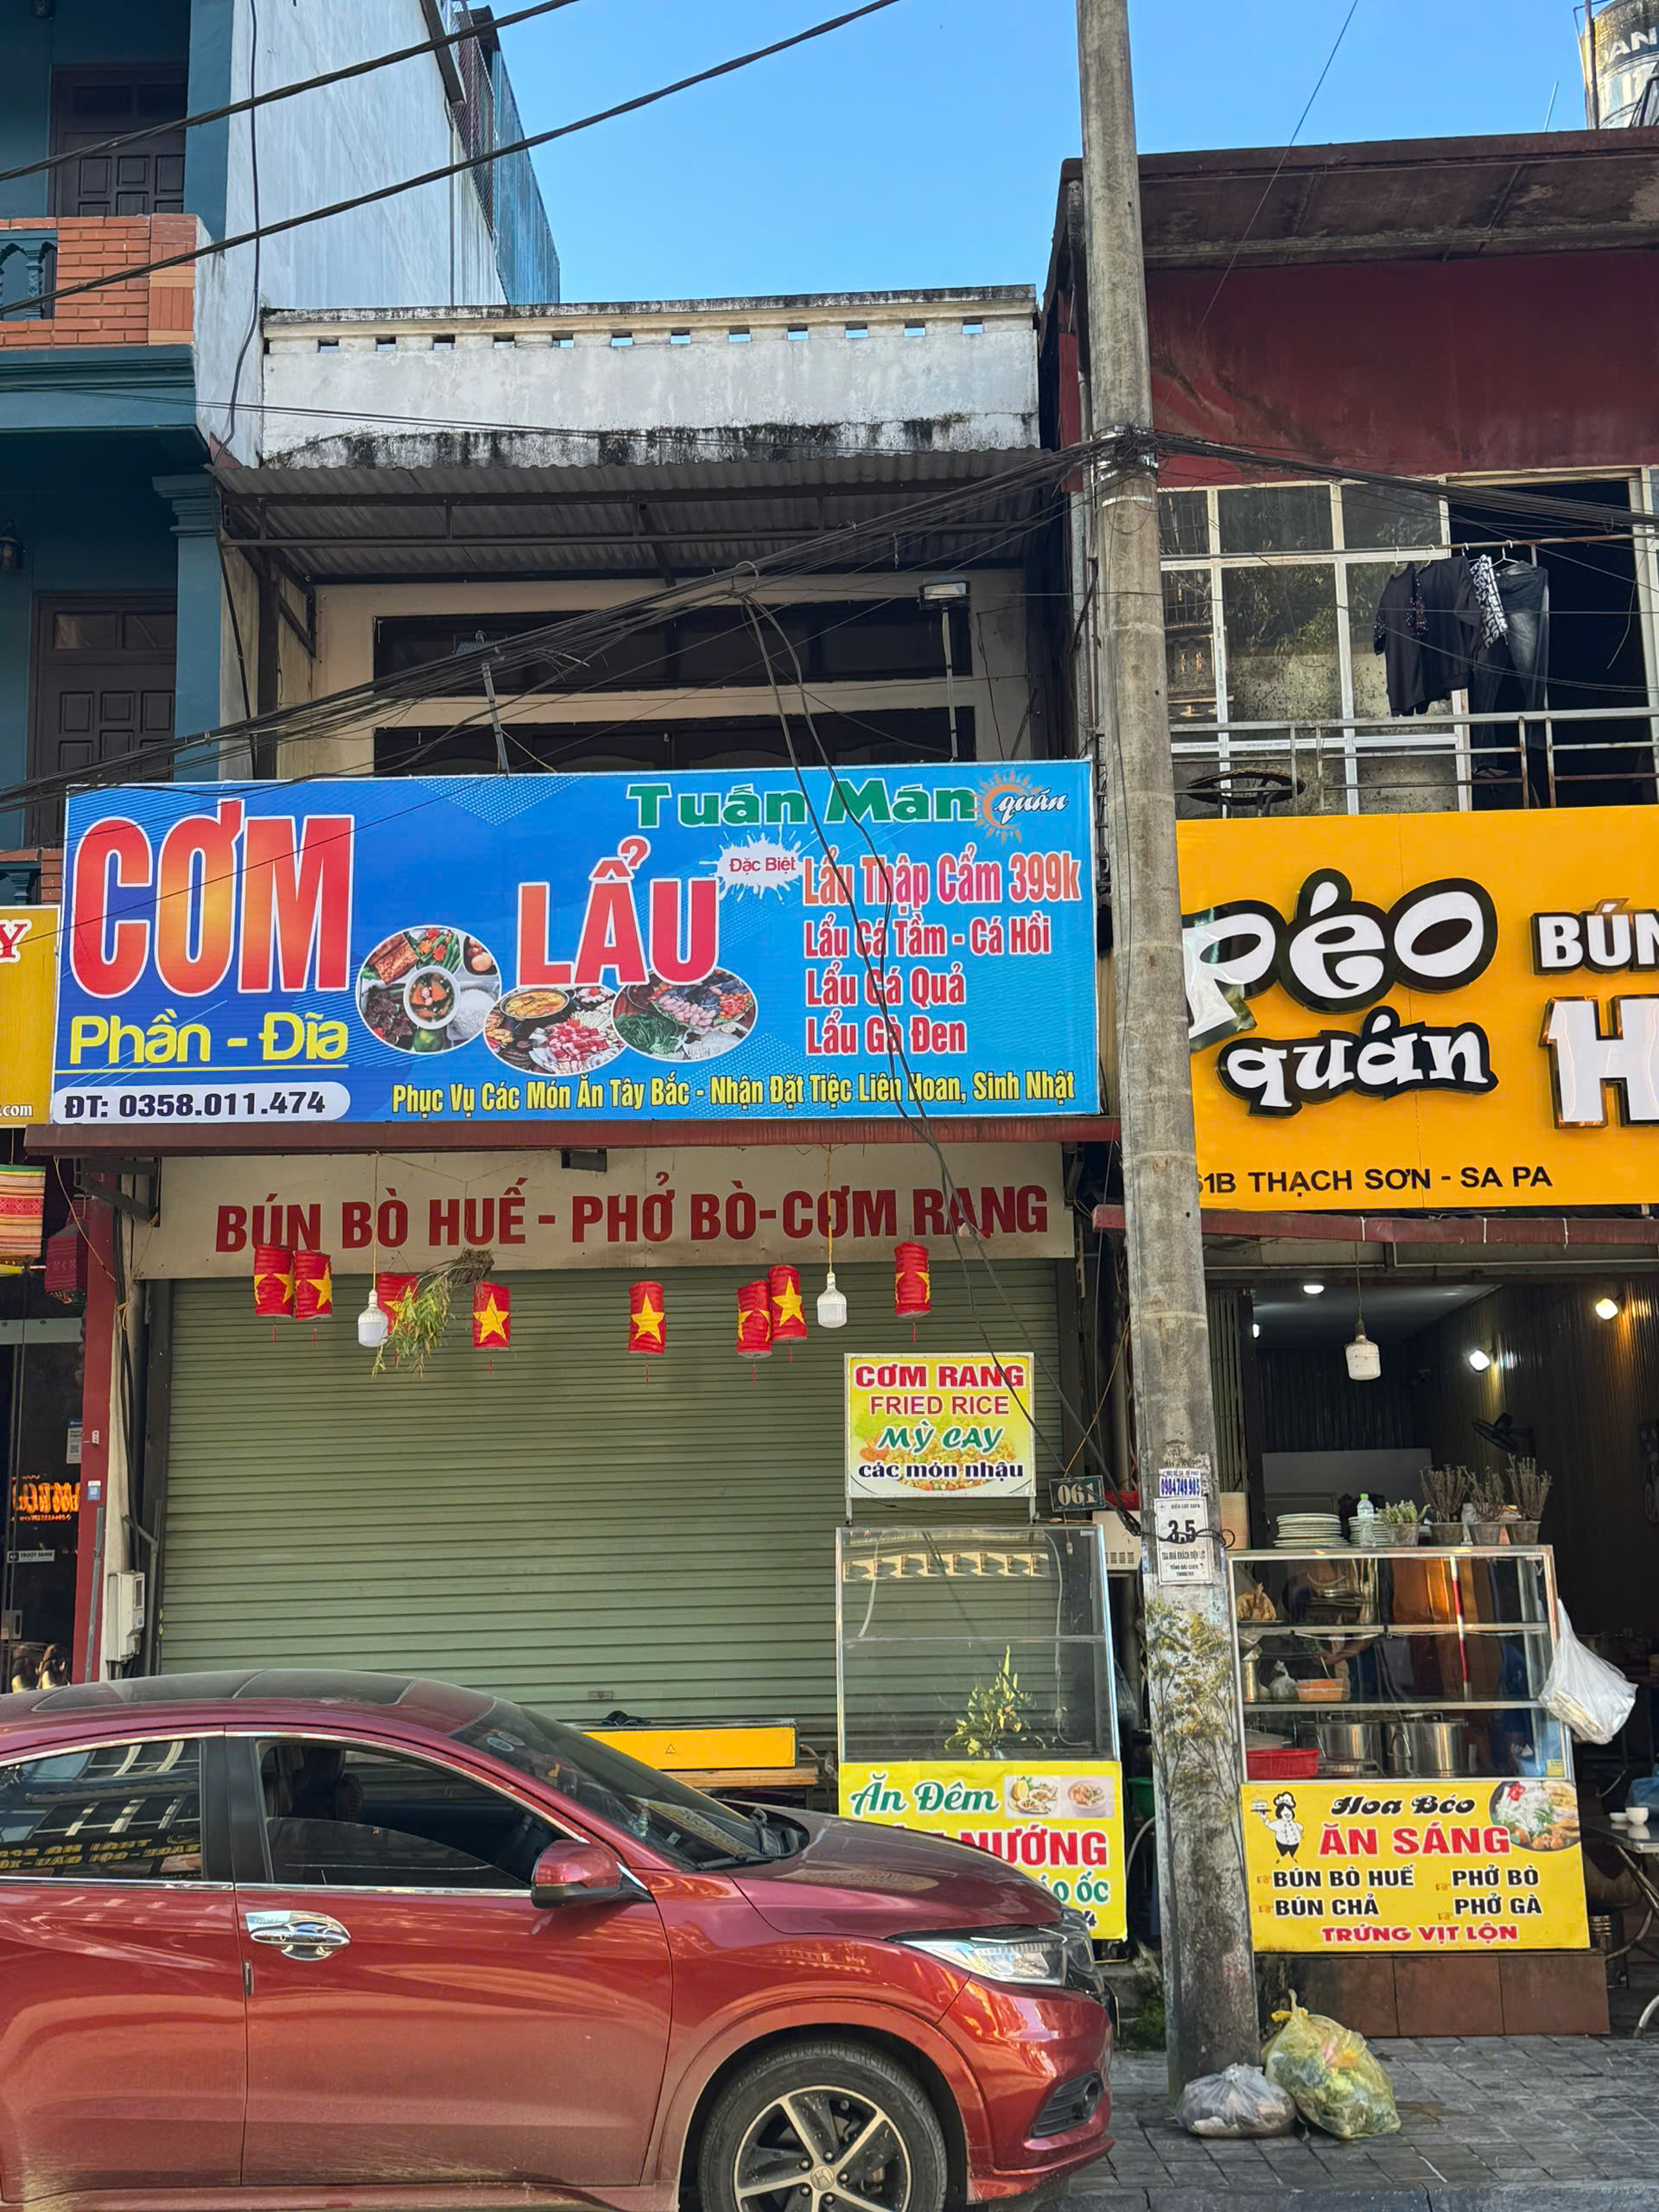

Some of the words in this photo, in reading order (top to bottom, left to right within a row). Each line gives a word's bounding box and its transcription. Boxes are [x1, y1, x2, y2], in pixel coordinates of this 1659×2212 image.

[824, 779, 977, 824] Mán
[993, 789, 1070, 826] quán
[729, 856, 761, 874] Đặc
[764, 855, 797, 873] Biệt
[803, 844, 855, 906] Lẩu
[861, 851, 930, 915] Thập
[938, 842, 1002, 903] Cẩm
[1009, 850, 1081, 901] 399k
[71, 798, 354, 999] CƠM
[518, 836, 720, 986] LẨU
[804, 912, 849, 959] Lẩu
[856, 917, 886, 957] Cá
[893, 913, 946, 957] Tầm
[969, 917, 1004, 956] Cá
[1008, 911, 1052, 955] Hồi
[805, 961, 857, 1007] Lẩu
[865, 967, 903, 1007] Cá
[910, 962, 967, 1008] Quả
[70, 1008, 211, 1065] Phần
[259, 1012, 349, 1061] Đĩa
[805, 1009, 857, 1056] Lẩu
[866, 1016, 903, 1054] Gà
[910, 1015, 967, 1054] Đen
[1222, 1009, 1493, 1112] quán
[65, 1095, 109, 1118] ĐT:
[118, 1090, 327, 1118] 0358.011.474
[392, 1083, 444, 1119] Phục
[449, 1083, 475, 1118] Vụ
[481, 1081, 519, 1111] Các
[526, 1080, 571, 1109] Món
[576, 1074, 603, 1109] Ăn
[609, 1077, 645, 1110] Tây
[652, 1071, 690, 1106] Bắc
[710, 1075, 763, 1110] Nhận
[770, 1075, 804, 1109] Đặt
[809, 1074, 852, 1109] Tiệc
[858, 1074, 901, 1103] Liên
[909, 1072, 967, 1103] Hoan,
[972, 1071, 1019, 1100] Sinh
[1026, 1071, 1076, 1105] Nhật
[1249, 1170, 1352, 1198] THẠCH
[1364, 1168, 1431, 1191] SƠN
[1460, 1166, 1503, 1189] SA
[1512, 1166, 1553, 1188] PA
[216, 1193, 321, 1252] BÚN
[341, 1187, 408, 1249] BÒ
[428, 1178, 526, 1247] HUẾ
[572, 1171, 676, 1243] PHỞ
[913, 1185, 1047, 1236] RANG
[855, 1364, 926, 1387] CƠM
[939, 1366, 1024, 1387] RANG
[871, 1396, 943, 1414] FRIED
[952, 1396, 1009, 1414] RICE
[878, 1421, 934, 1452] MỲ
[943, 1428, 1003, 1452] CAY
[859, 1462, 901, 1478] các
[907, 1462, 957, 1478] món
[966, 1462, 1023, 1482] nhậu
[1058, 1483, 1097, 1505] 061
[851, 1773, 906, 1815] Ăn
[914, 1782, 1000, 1811] Đêm
[1331, 1796, 1402, 1815] Hoa
[1411, 1795, 1476, 1815] Béo
[1319, 1823, 1378, 1856] ĂN
[1393, 1821, 1510, 1855] SÁNG
[1274, 1867, 1322, 1888] BÚN
[1329, 1866, 1360, 1887] BÒ
[1368, 1863, 1414, 1887] HUẾ
[1452, 1864, 1499, 1887] PHỞ
[1507, 1865, 1539, 1886] BÒ
[1275, 1895, 1324, 1916] BÚN
[1332, 1893, 1379, 1916] CHẢ
[1455, 1893, 1501, 1915] PHỞ
[1510, 1893, 1542, 1915] GÀ
[1322, 1923, 1412, 1943] TRỨNG
[1418, 1925, 1460, 1946] VỊT
[1465, 1923, 1518, 1945] LỘN
